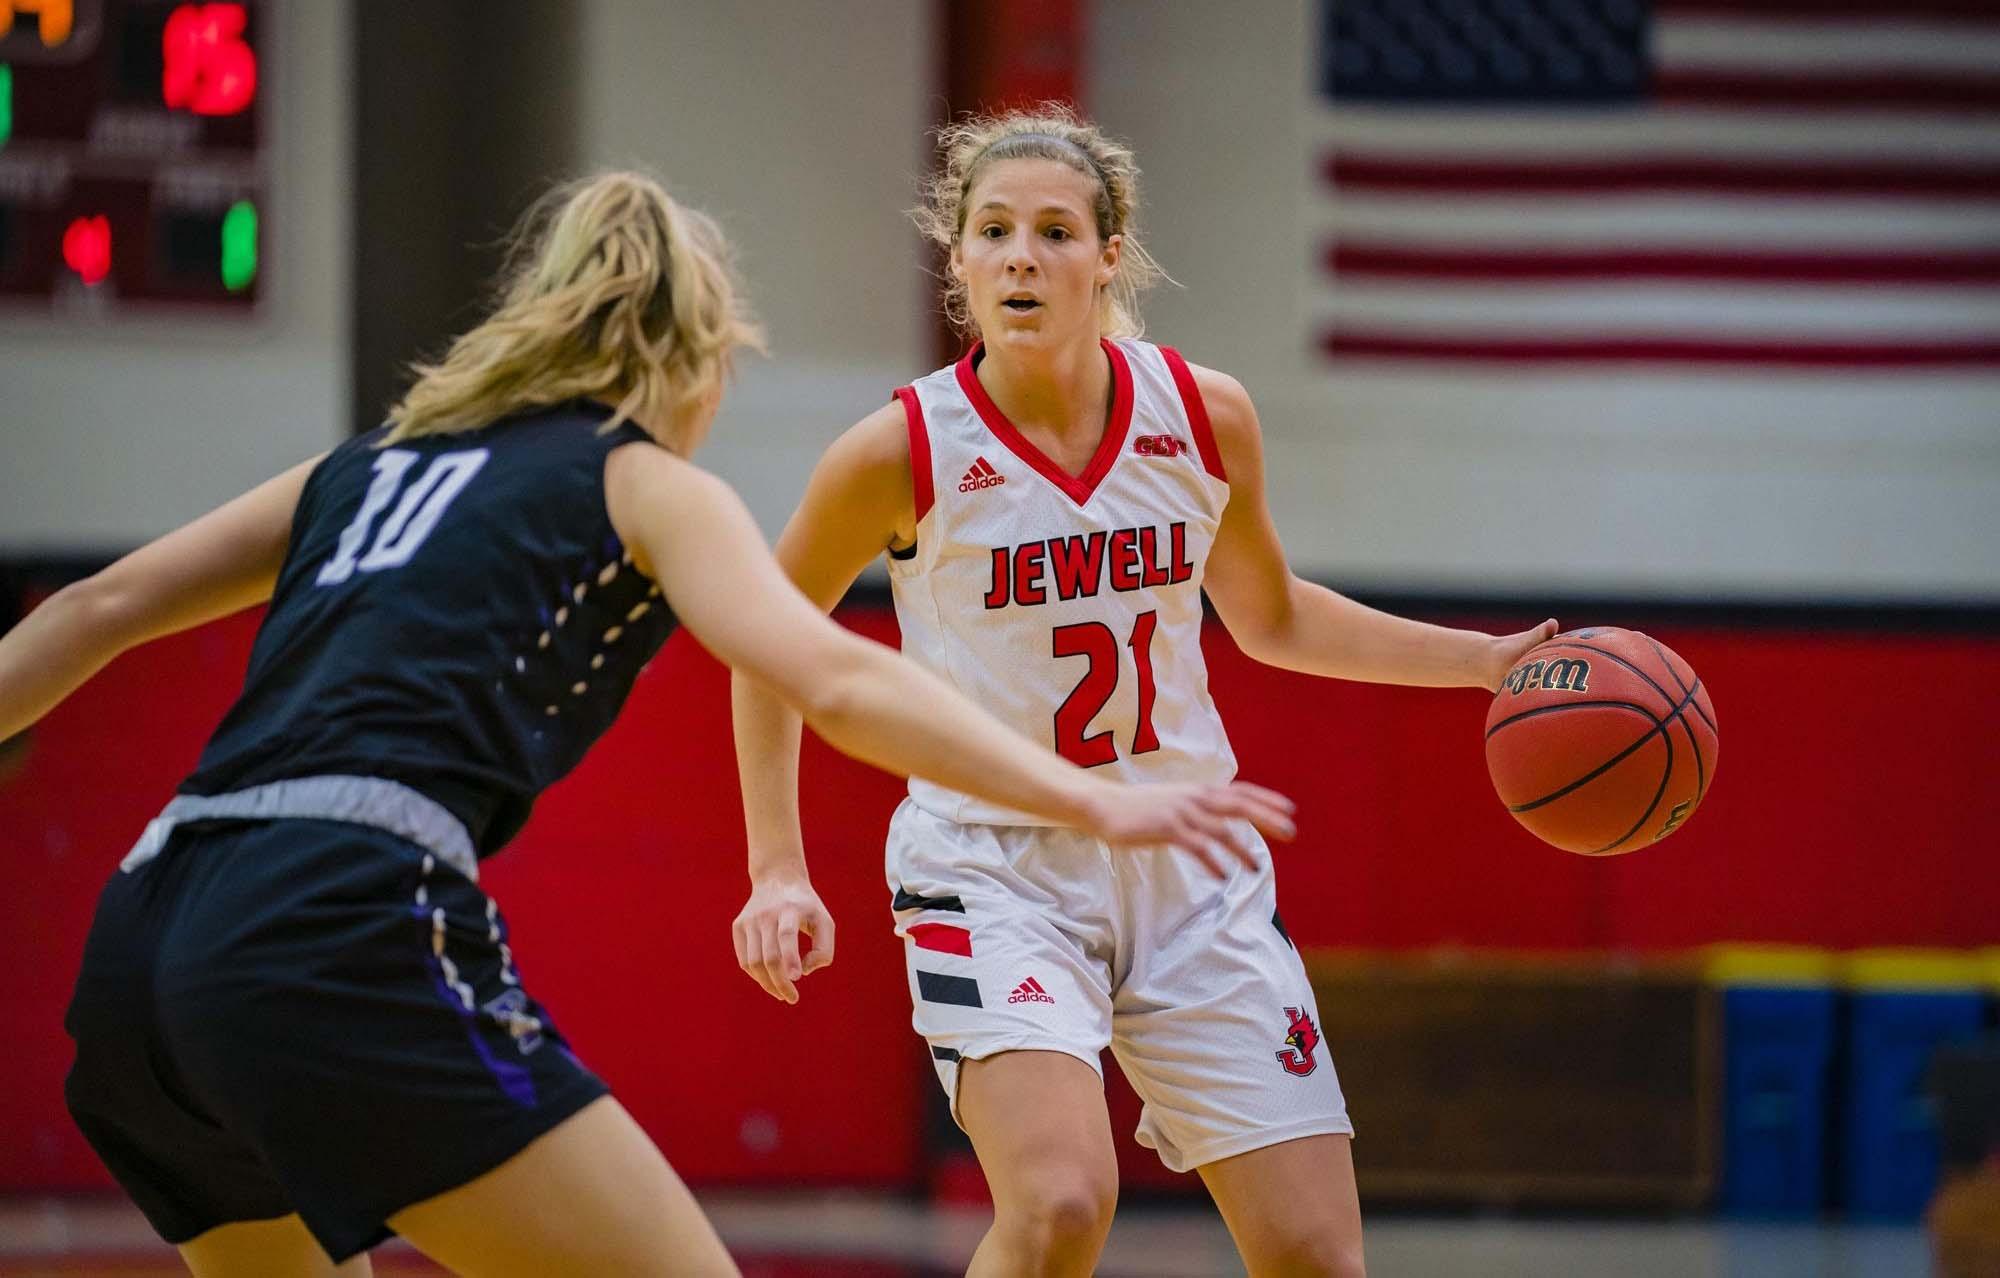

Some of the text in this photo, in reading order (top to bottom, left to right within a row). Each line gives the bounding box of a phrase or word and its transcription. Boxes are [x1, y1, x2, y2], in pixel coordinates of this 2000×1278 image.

[315, 447, 491, 586] 10
[958, 475, 1006, 493] adidas
[984, 521, 1194, 609] JEWELL
[1053, 610, 1160, 769] 21
[1007, 991, 1055, 1004] adidas
